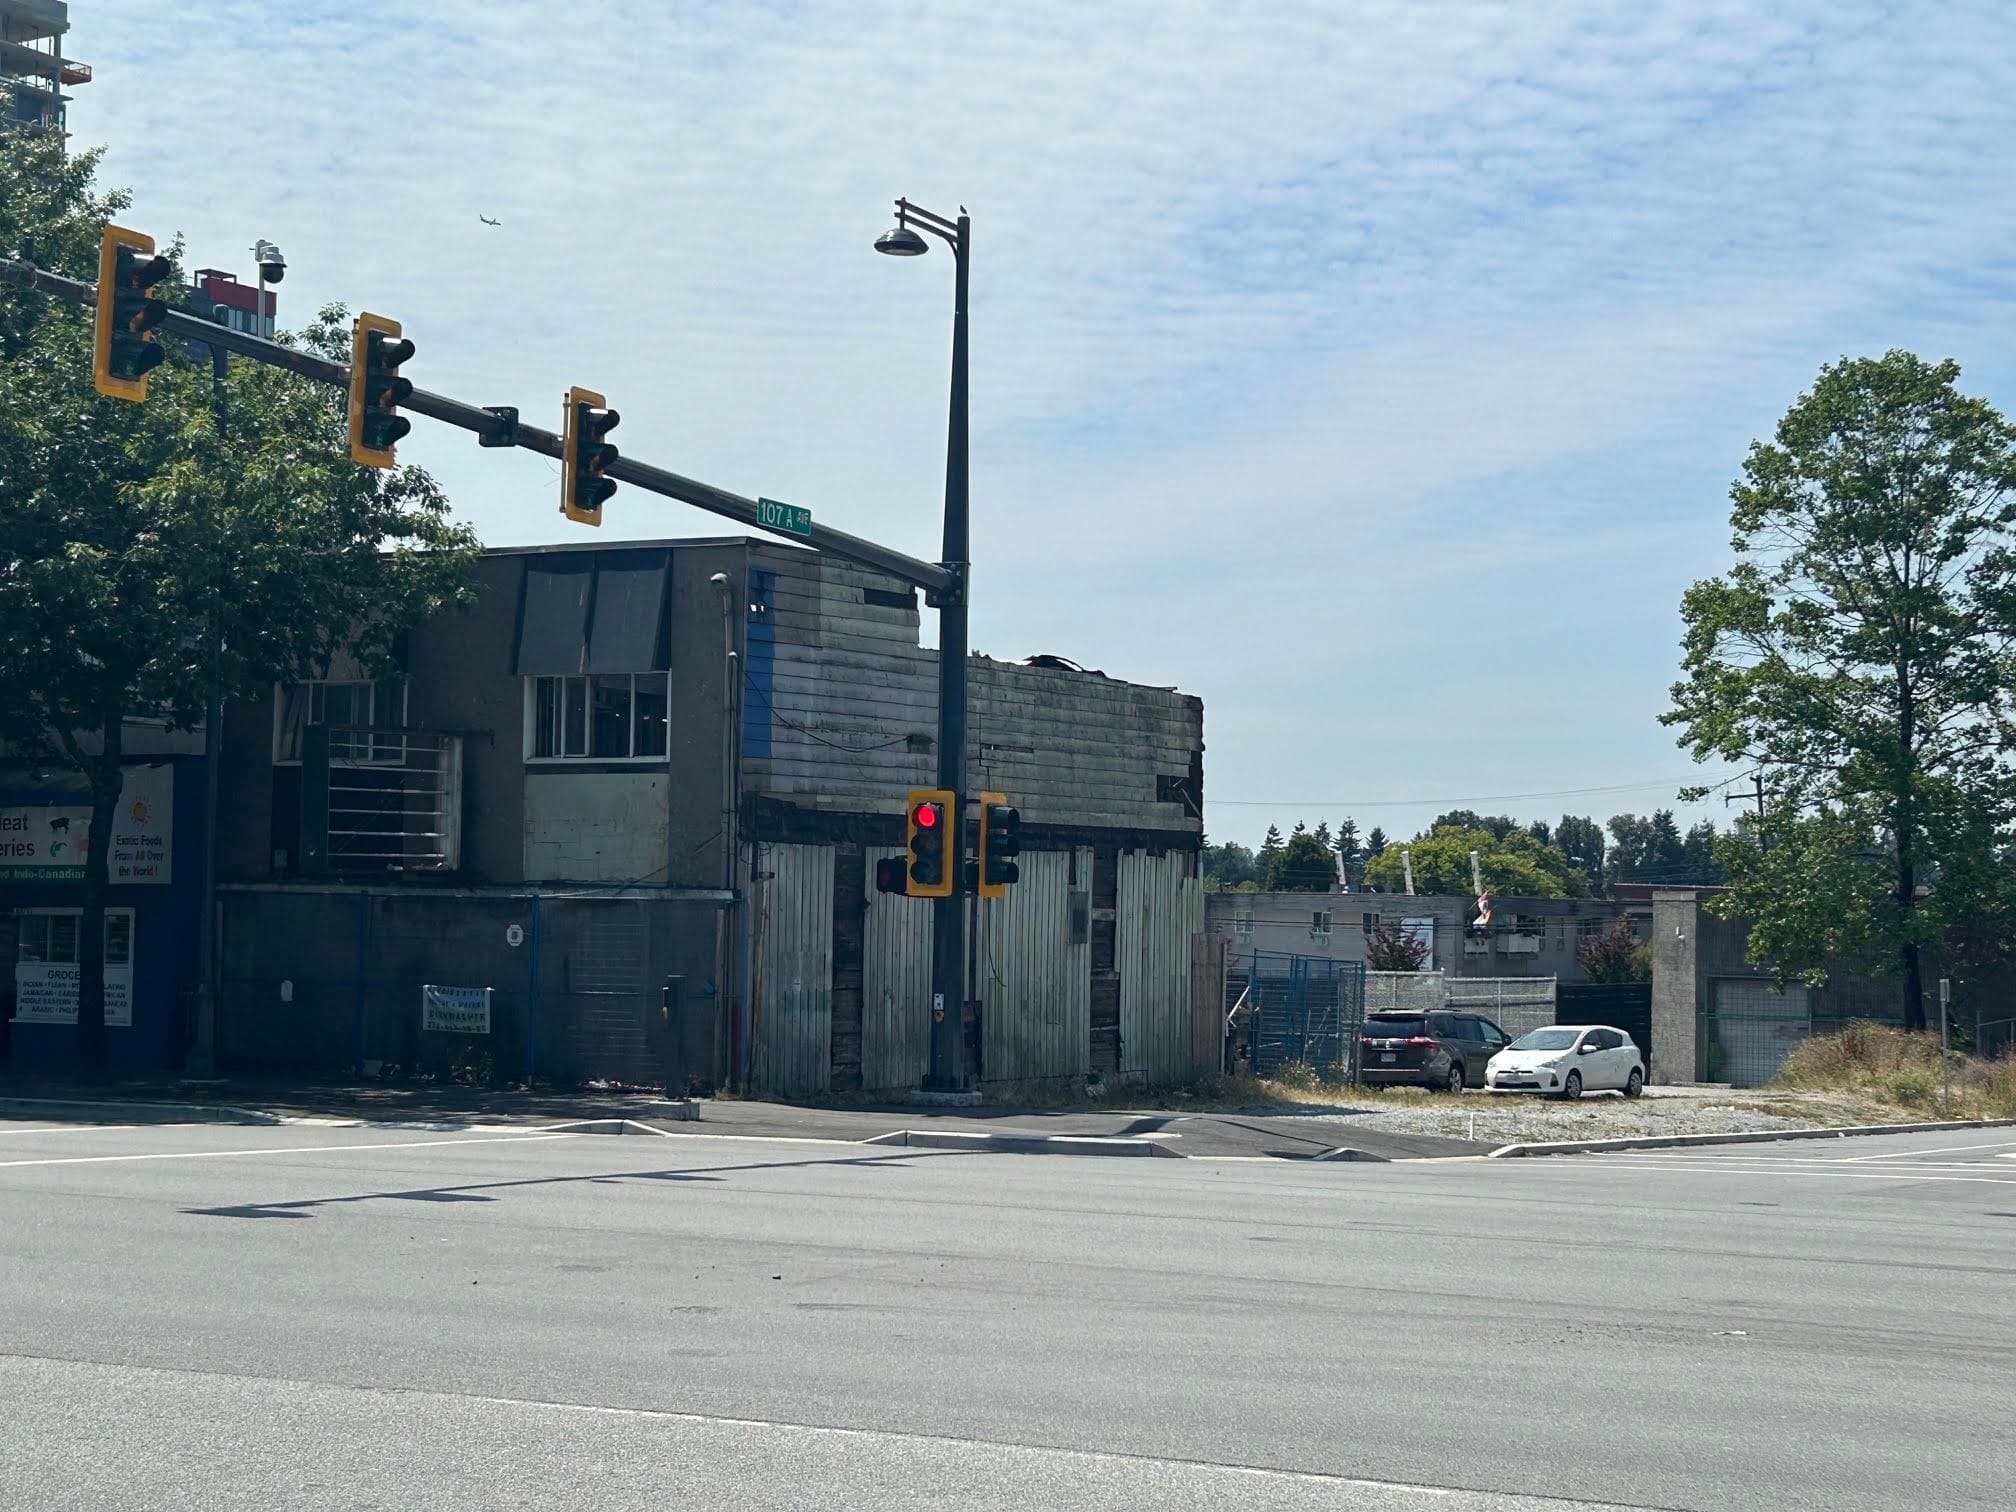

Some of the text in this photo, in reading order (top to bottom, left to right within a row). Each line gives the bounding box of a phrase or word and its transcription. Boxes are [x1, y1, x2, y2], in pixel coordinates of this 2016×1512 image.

[761, 502, 783, 525] 107
[786, 508, 793, 528] A
[0, 813, 29, 831] eat
[141, 835, 163, 847] Foods
[147, 850, 164, 862] Over
[48, 969, 80, 980] GROCE
